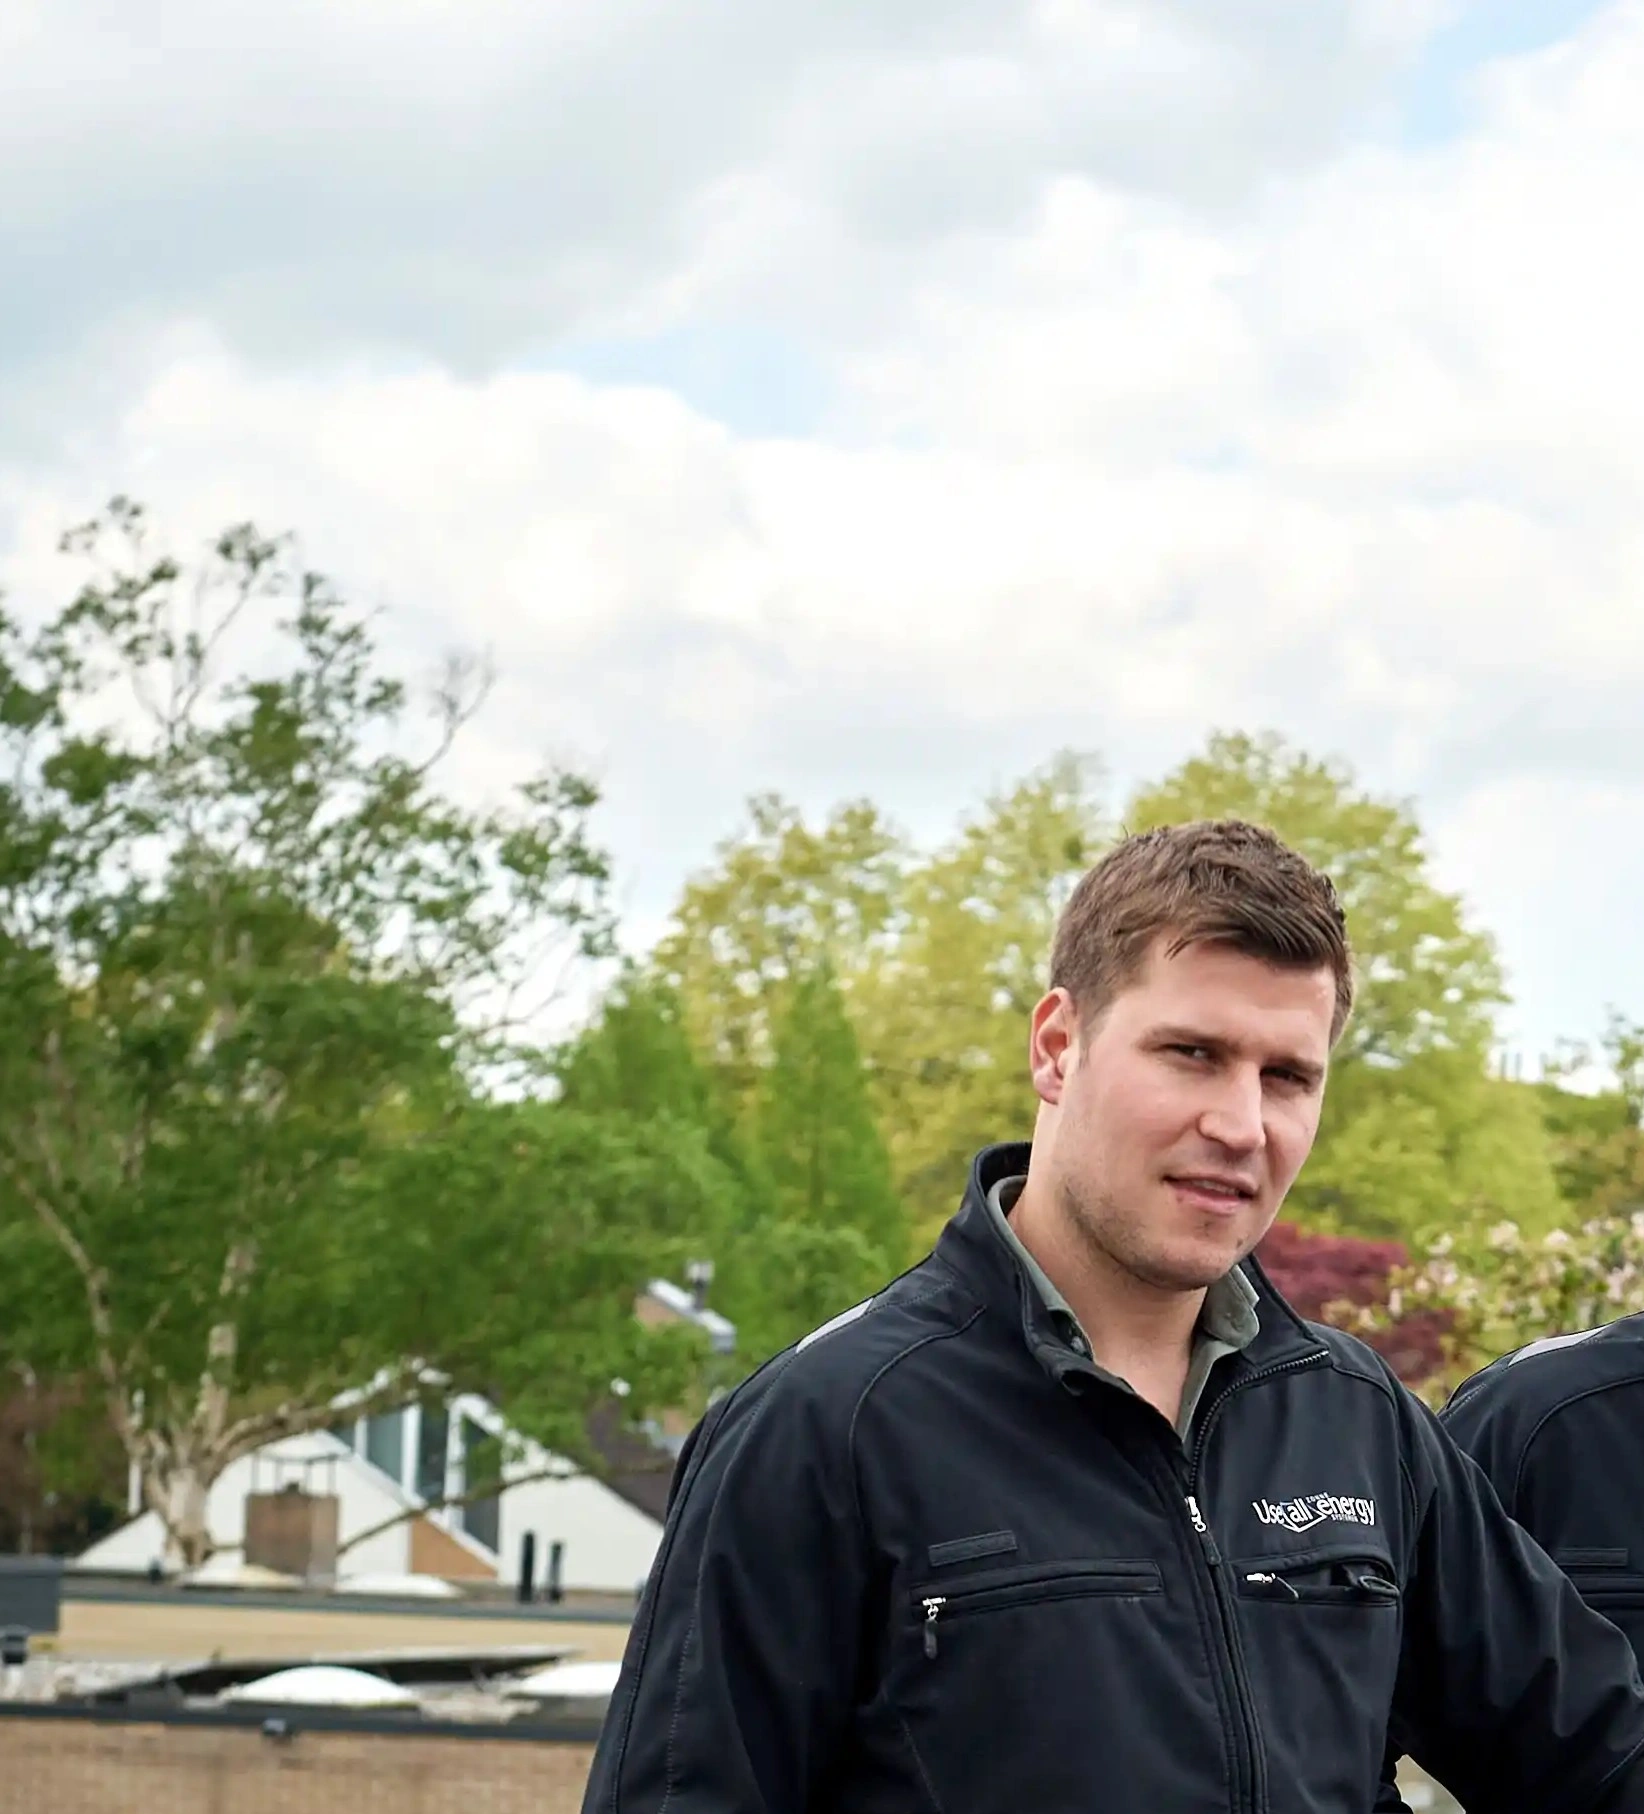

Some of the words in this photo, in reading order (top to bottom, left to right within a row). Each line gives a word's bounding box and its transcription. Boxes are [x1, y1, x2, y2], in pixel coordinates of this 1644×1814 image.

[1252, 1499, 1285, 1524] Use
[1288, 1497, 1314, 1523] all
[1316, 1496, 1375, 1526] energy
